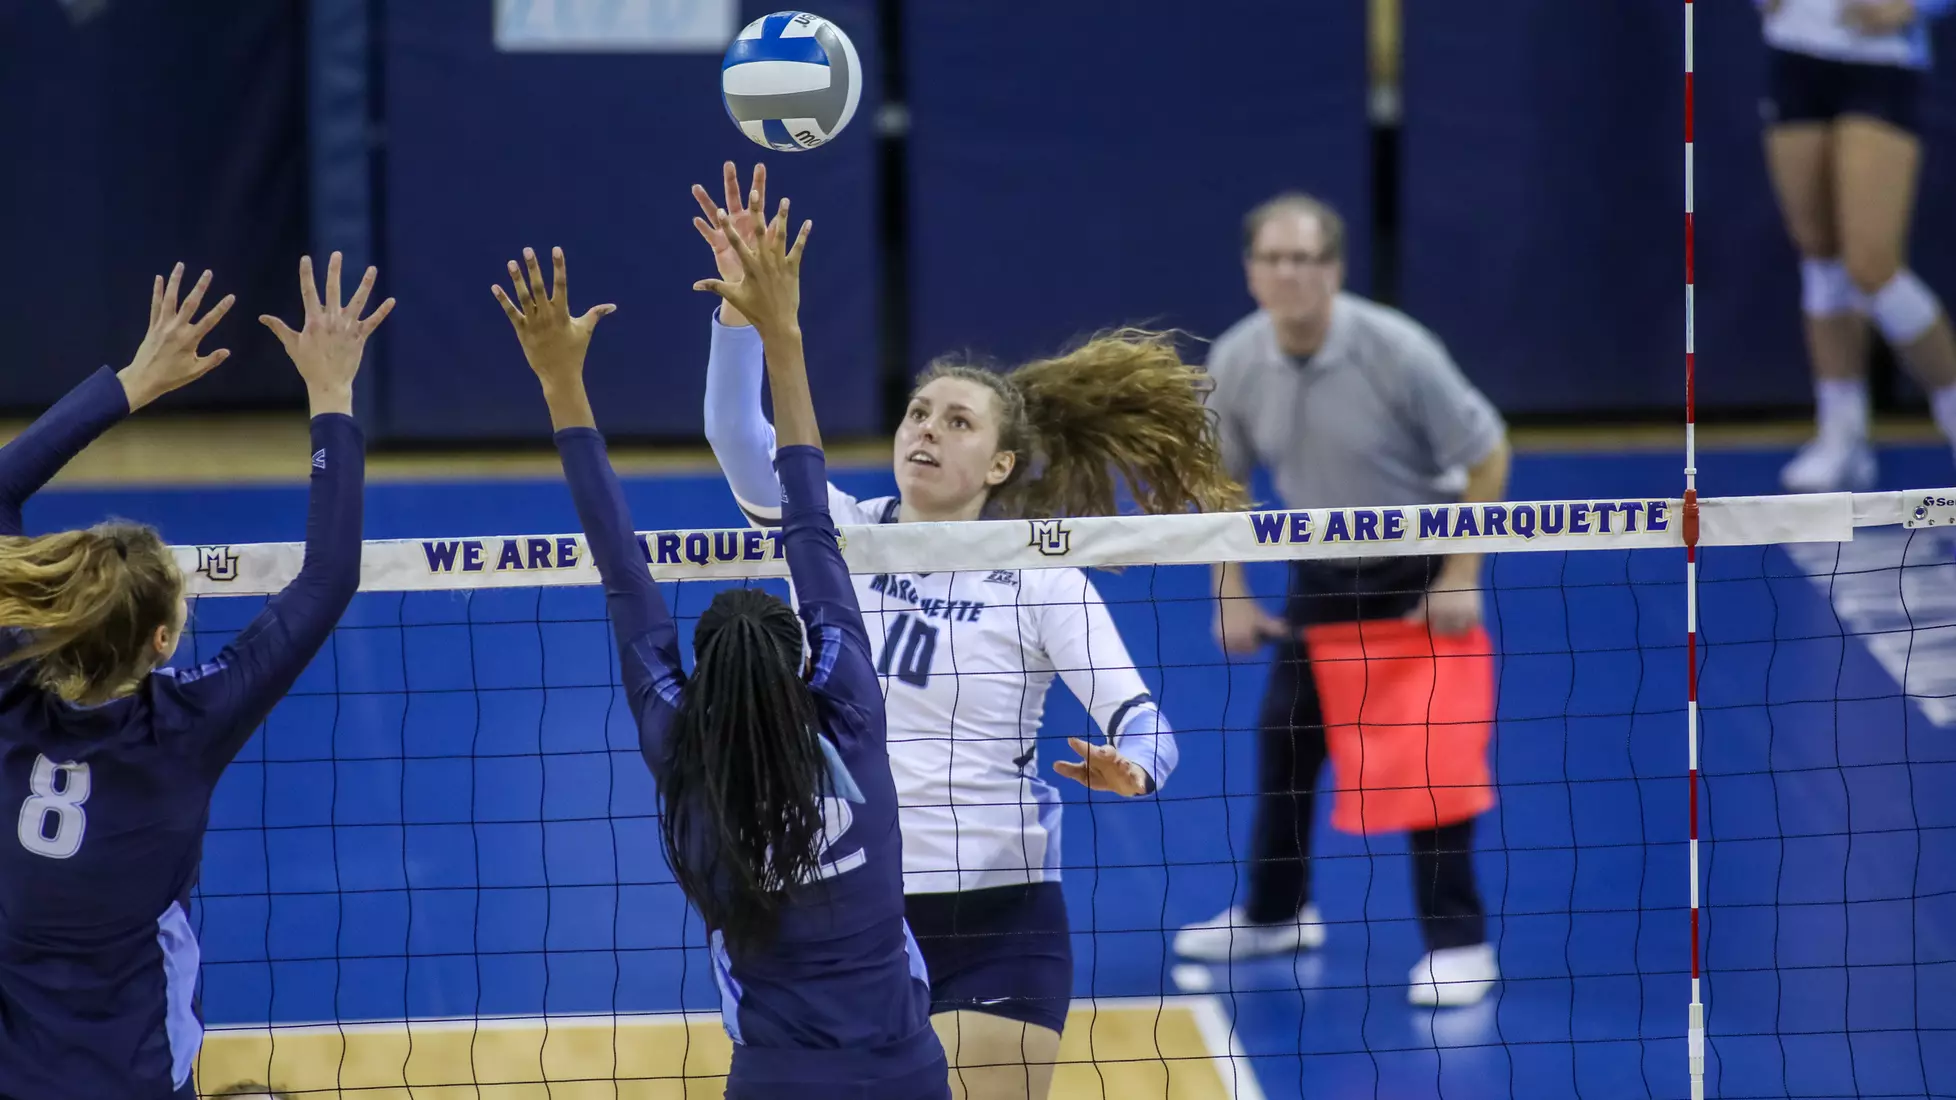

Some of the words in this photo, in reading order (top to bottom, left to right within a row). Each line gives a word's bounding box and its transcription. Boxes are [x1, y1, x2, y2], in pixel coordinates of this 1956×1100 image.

[1247, 509, 1315, 545] WE
[1320, 507, 1408, 543] ARE
[1416, 499, 1673, 541] MARQUETTE
[1936, 497, 1956, 507] Se
[421, 540, 487, 575] WE
[495, 535, 584, 572] ARE
[1027, 519, 1071, 556] MU
[197, 545, 239, 581] MU
[877, 612, 939, 689] 10
[17, 752, 92, 859] 8
[762, 794, 867, 892] 2
